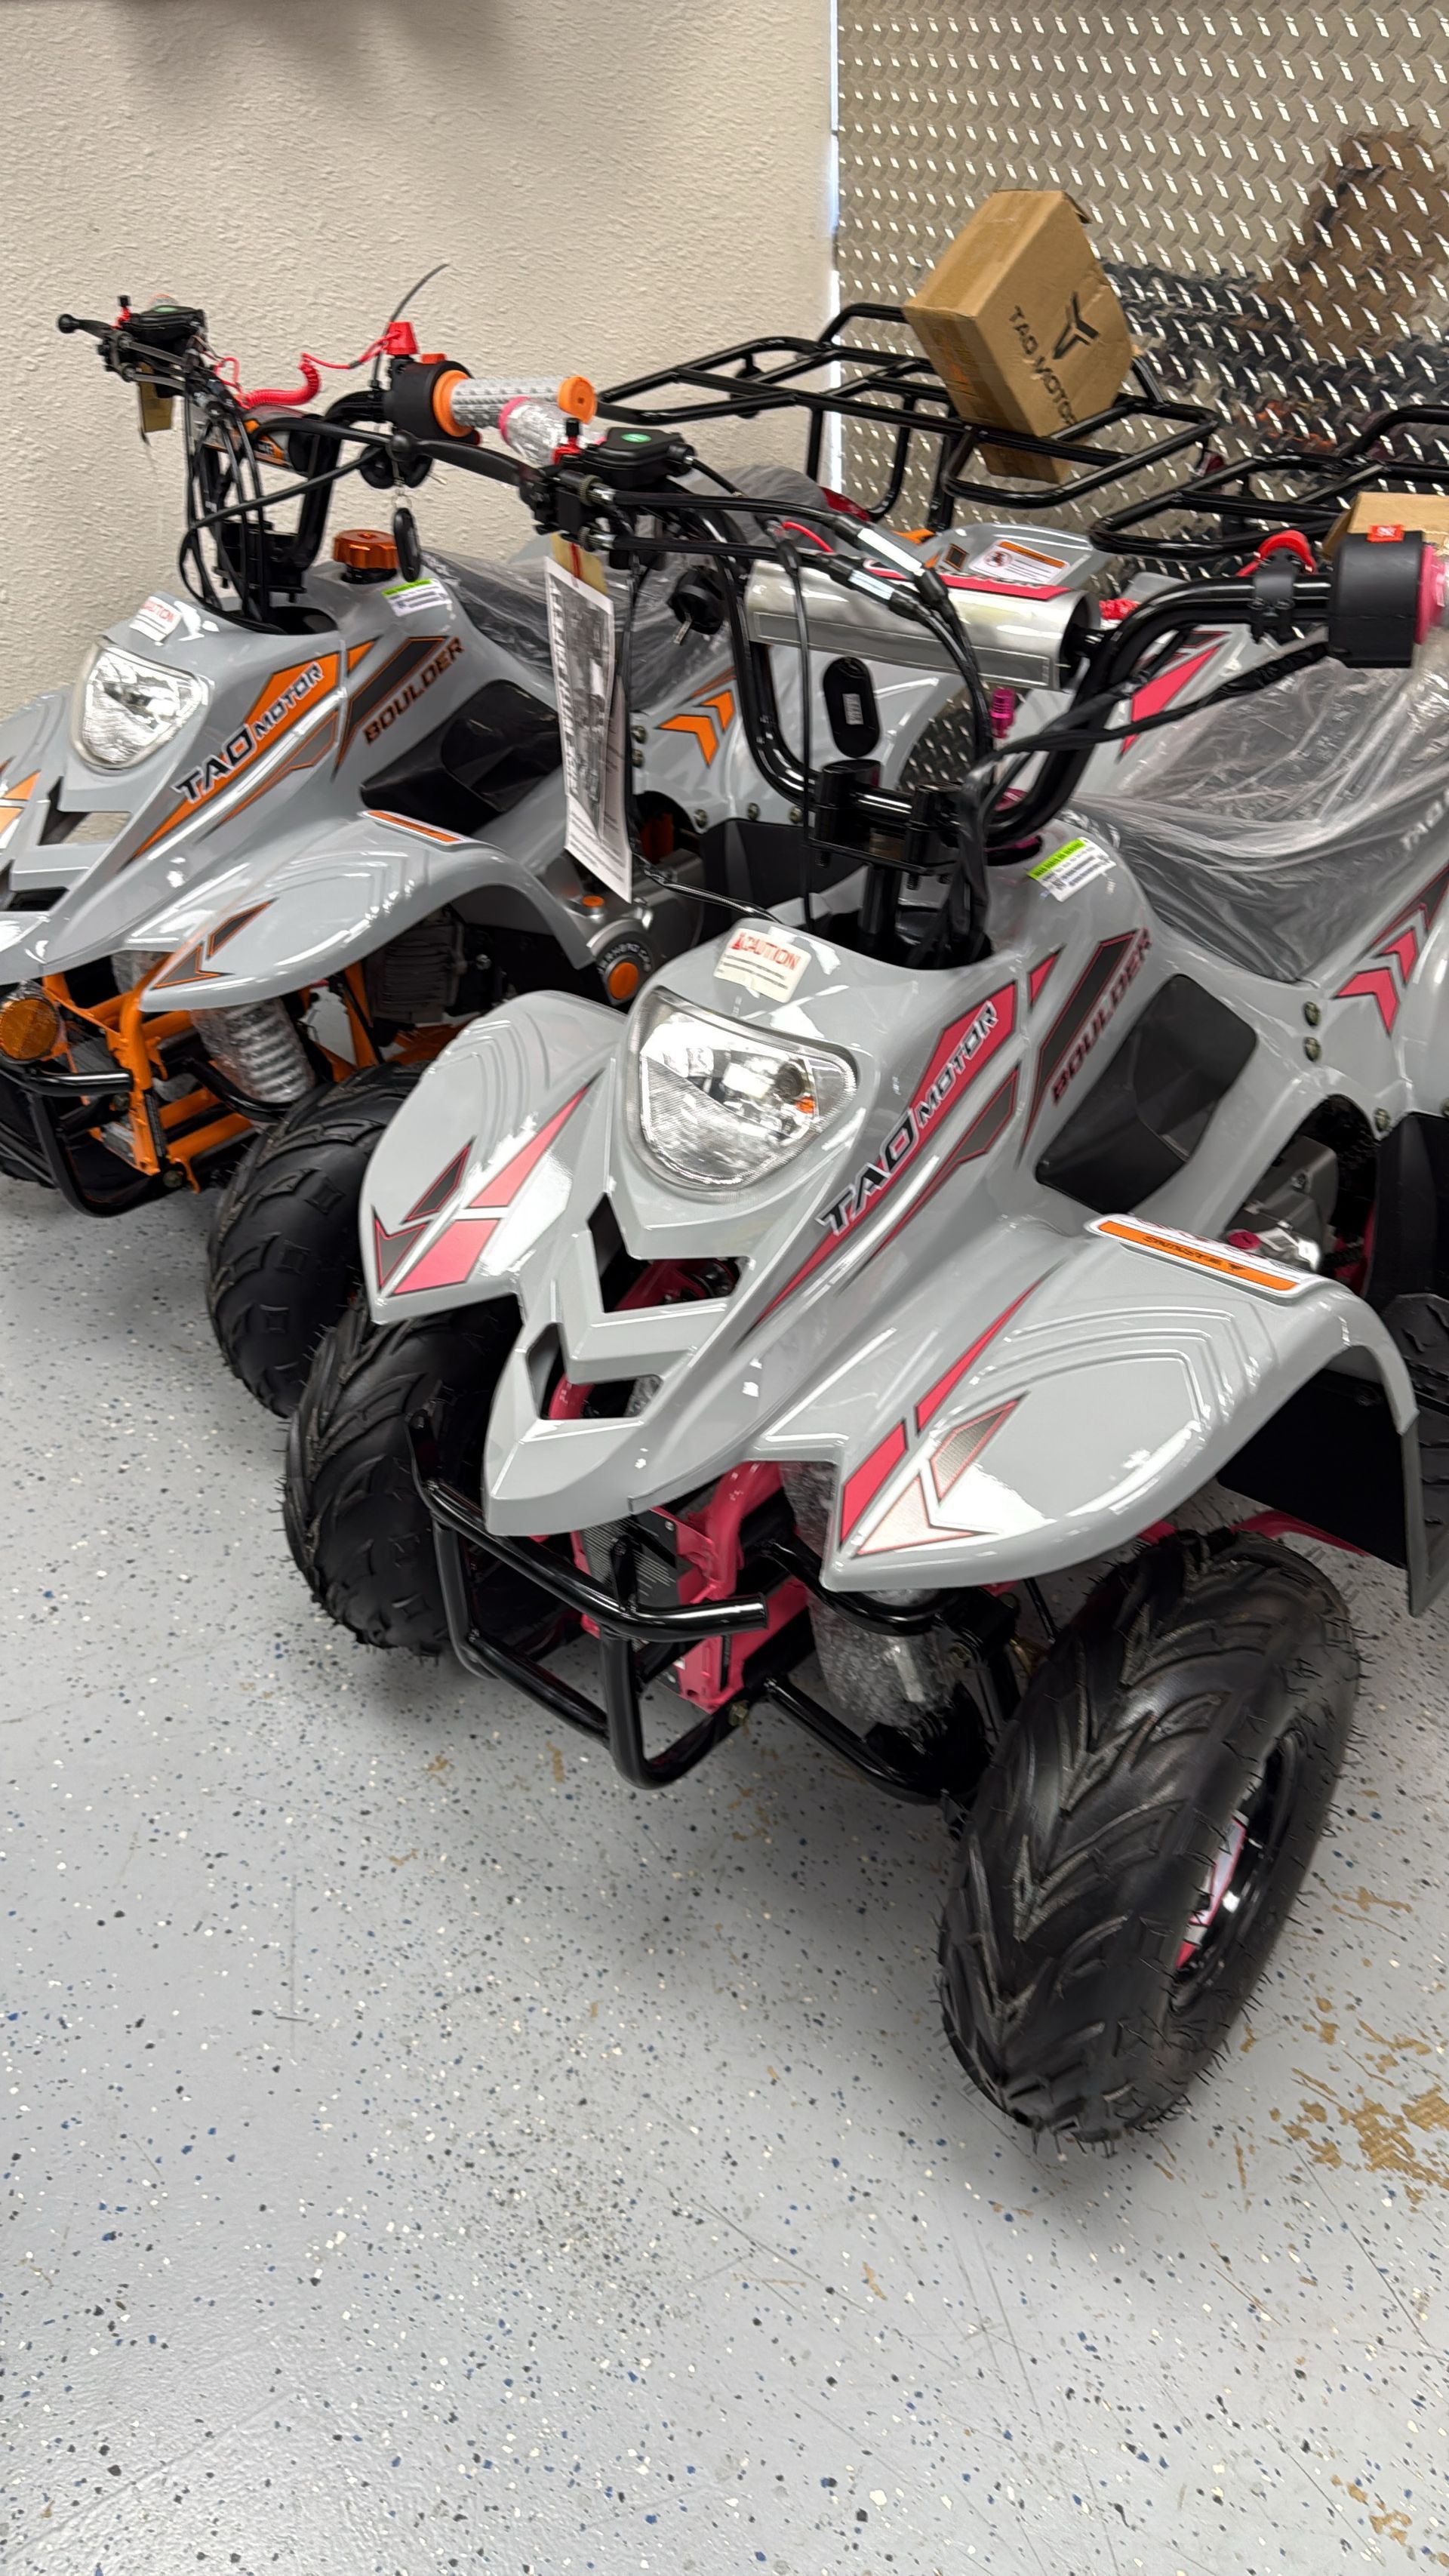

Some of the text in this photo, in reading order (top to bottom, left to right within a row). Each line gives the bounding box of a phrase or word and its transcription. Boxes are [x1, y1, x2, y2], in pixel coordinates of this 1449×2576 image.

[1009, 305, 1038, 355] TAO
[171, 661, 325, 804] TAO MOTOR
[363, 636, 465, 745] BOULDER
[741, 935, 801, 971] CAUTION
[1052, 927, 1152, 1105] BOULDER
[814, 1000, 999, 1236] TAO MOTOR
